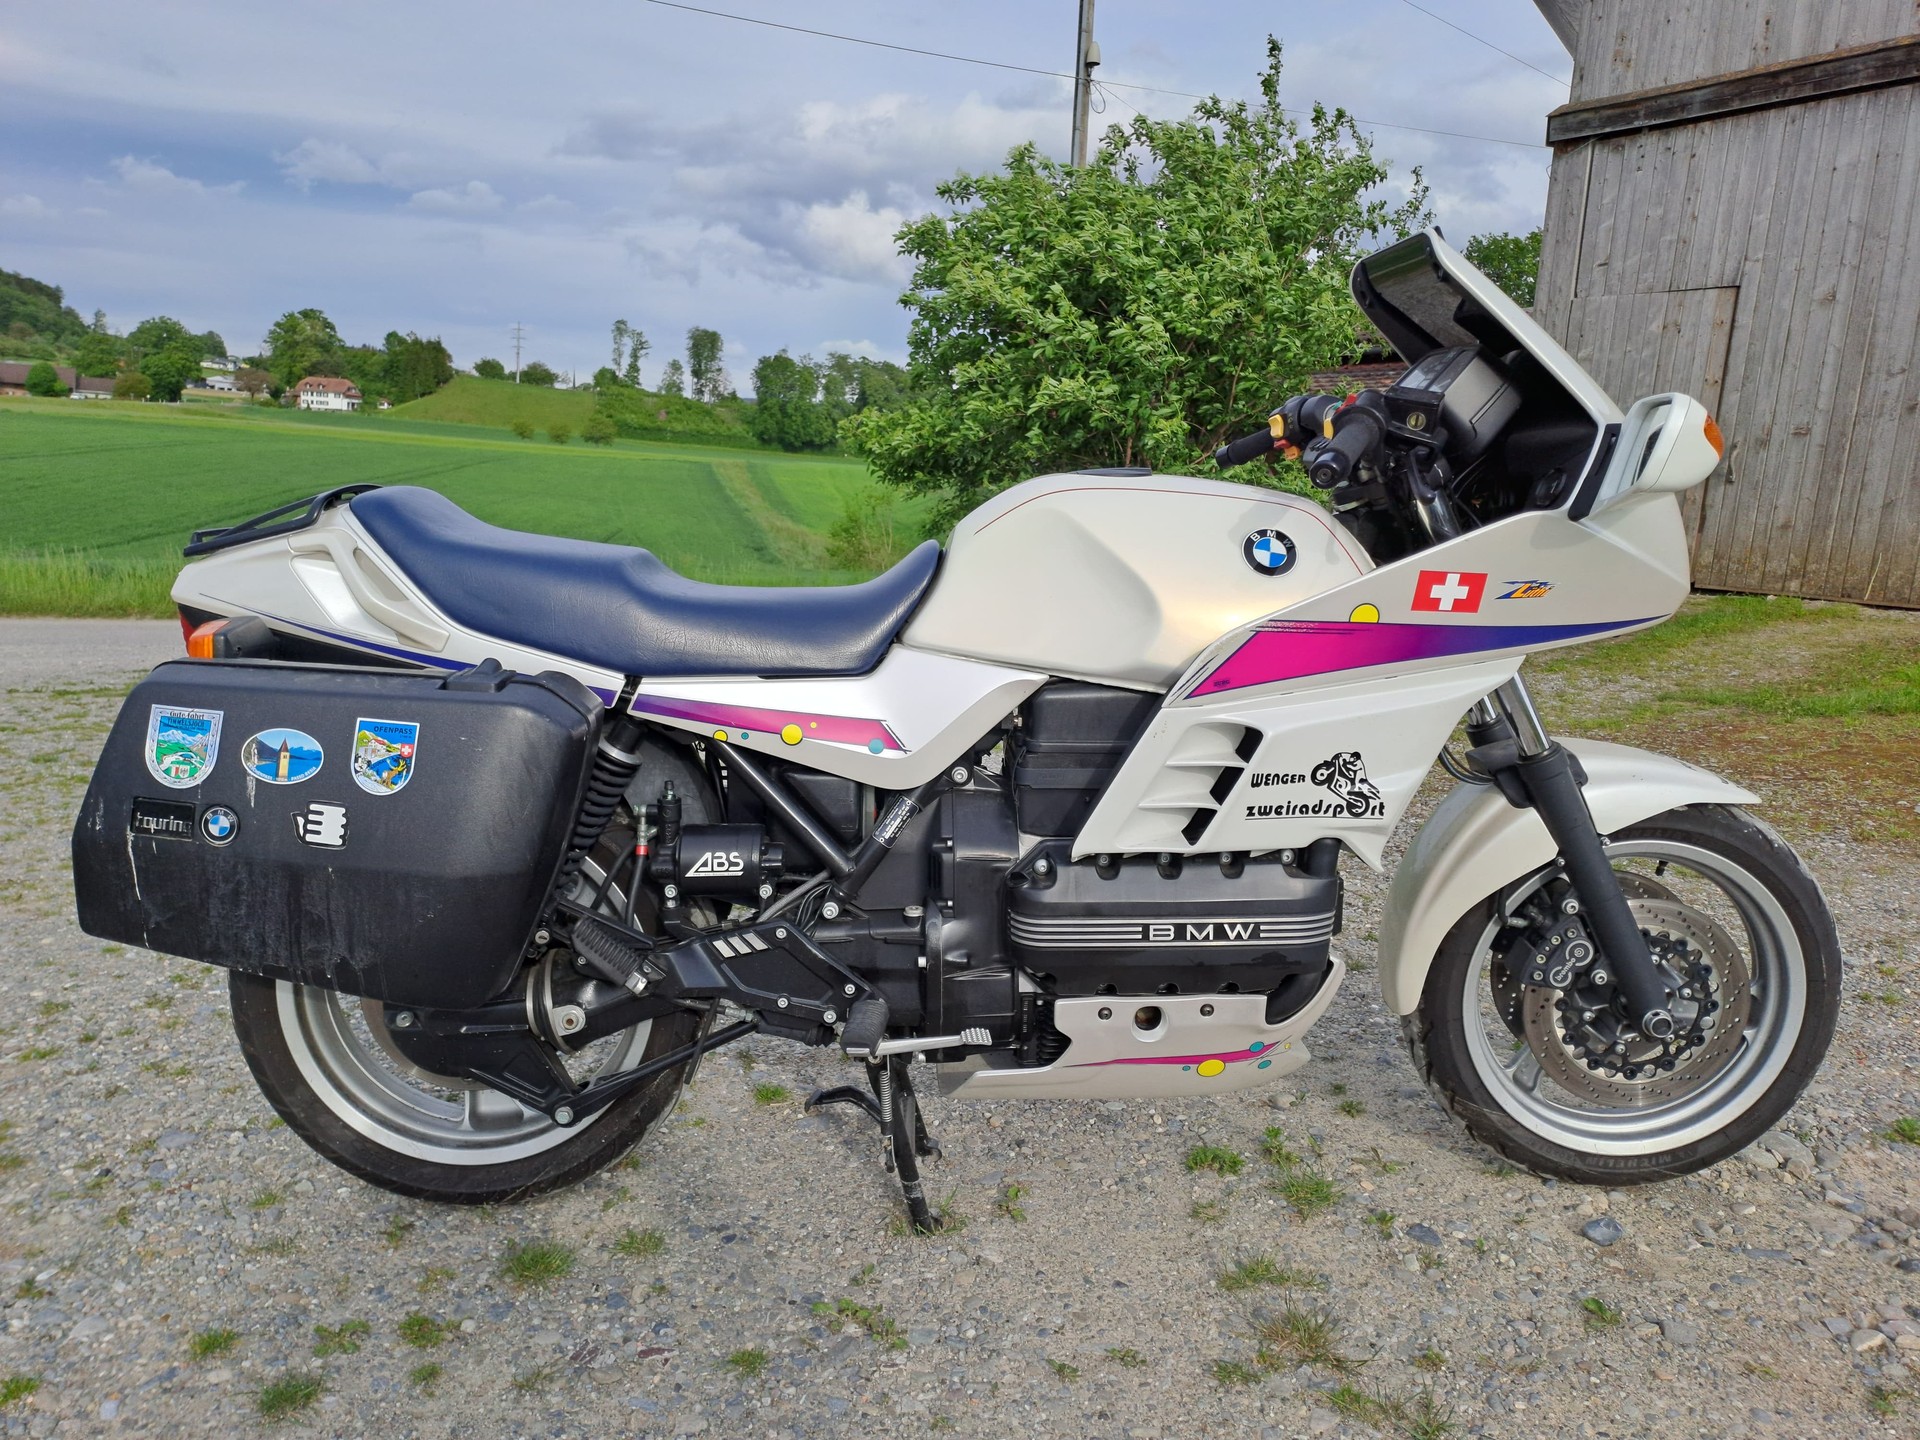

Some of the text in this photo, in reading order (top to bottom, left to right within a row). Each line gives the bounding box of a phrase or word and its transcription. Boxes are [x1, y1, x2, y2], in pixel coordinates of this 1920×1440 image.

[1250, 530, 1293, 547] BMW
[374, 726, 413, 734] OFENPASS
[1250, 773, 1306, 788] WENGER
[206, 809, 235, 823] BMW
[1246, 799, 1386, 818] zweiradsport
[685, 851, 744, 877] ABS
[1149, 923, 1255, 941] BMW
[1555, 957, 1576, 981] brembo
[1585, 1153, 1672, 1169] MICHELIN
